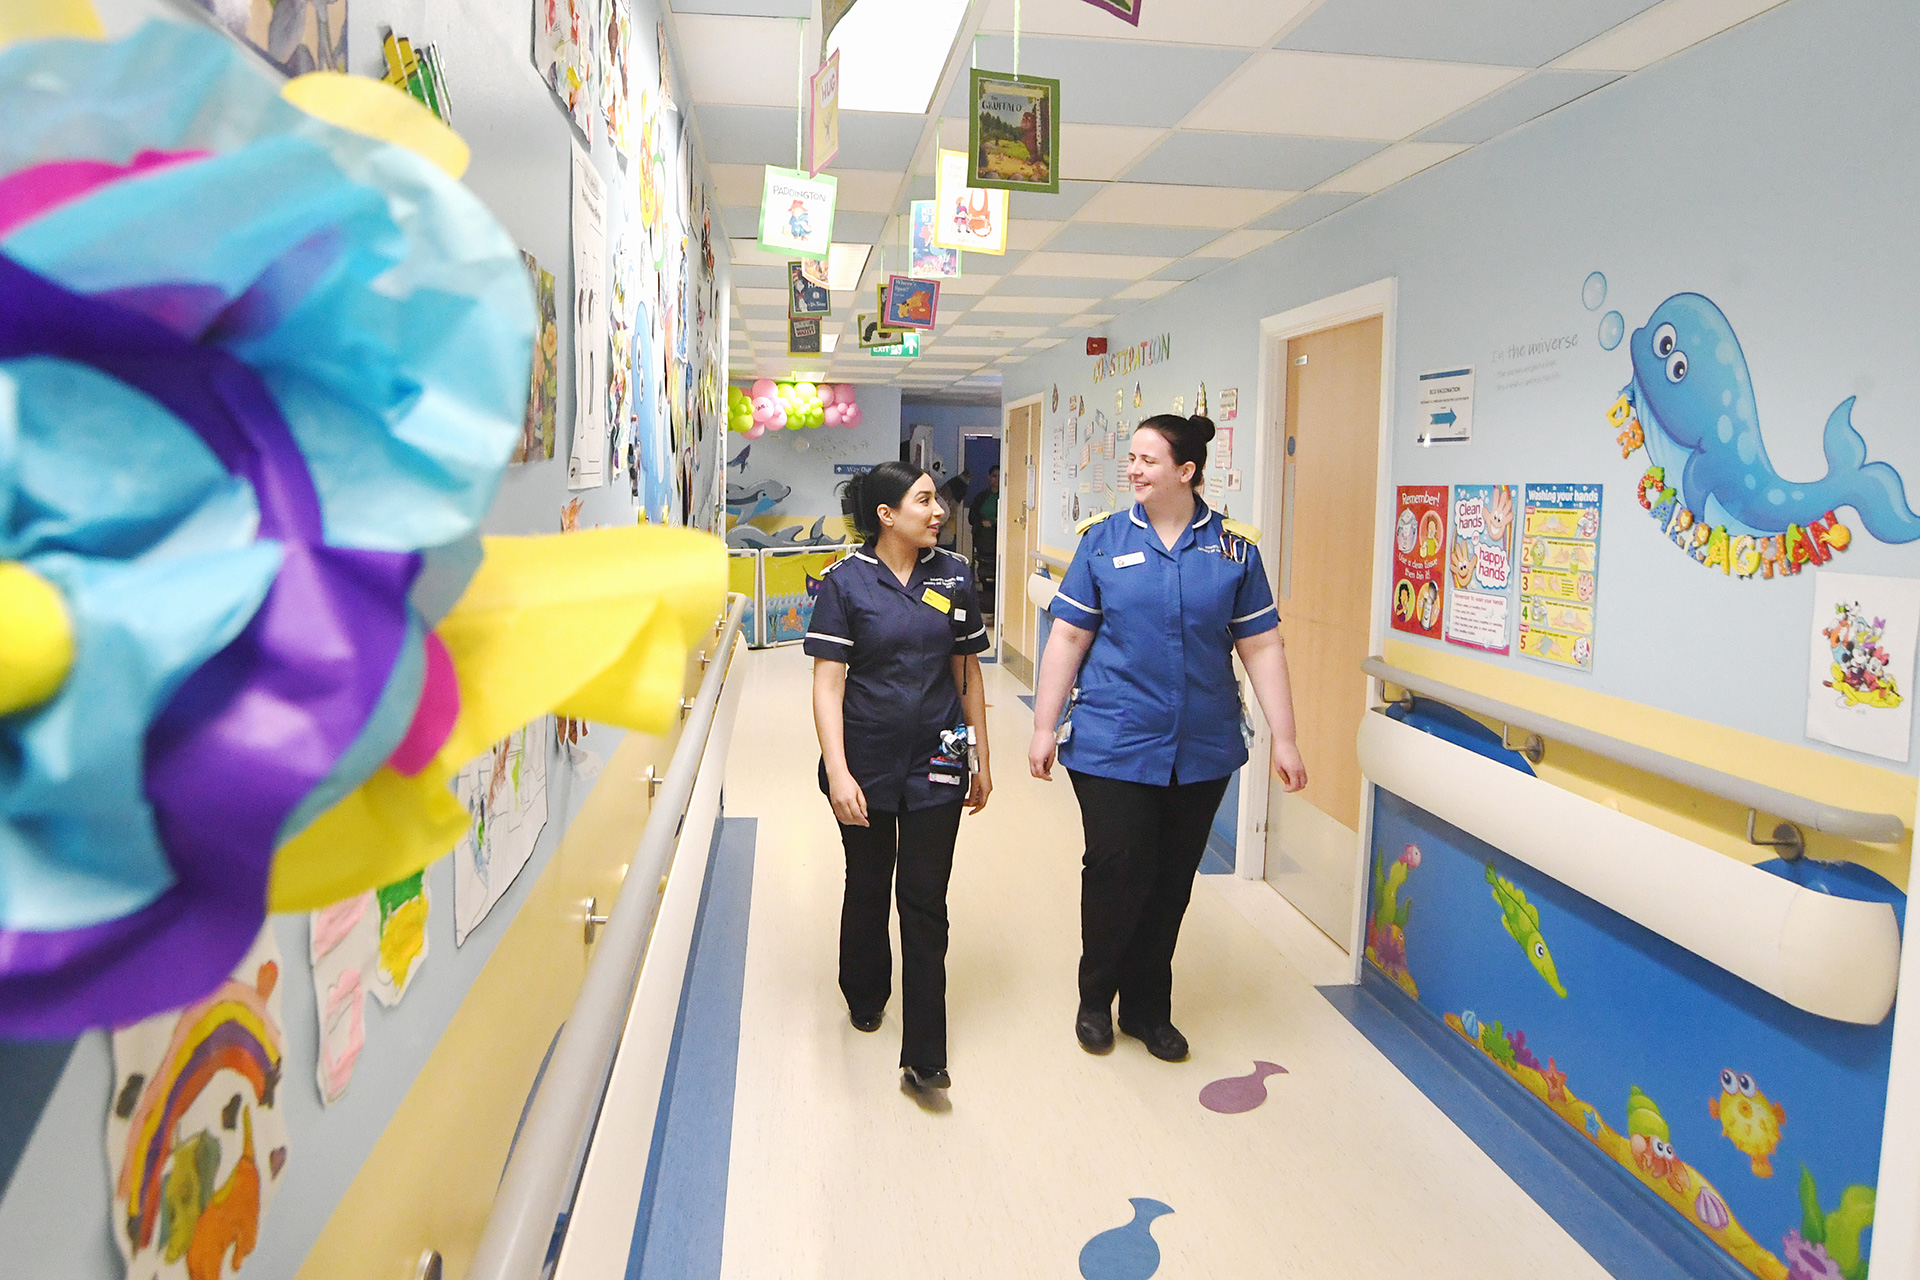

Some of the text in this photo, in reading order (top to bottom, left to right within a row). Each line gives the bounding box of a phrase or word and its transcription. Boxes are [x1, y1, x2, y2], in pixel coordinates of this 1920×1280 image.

[821, 74, 836, 102] HUG
[981, 100, 1022, 112] GRUFFALO
[773, 184, 827, 202] PADDINGTON
[1508, 344, 1525, 359] the
[1528, 333, 1578, 356] universe
[1093, 332, 1170, 384] CONSTIPATION
[1605, 395, 1644, 459] DR
[846, 466, 860, 475] Way
[1402, 490, 1440, 507] Remember!
[1528, 489, 1598, 503] Washing your hands
[1459, 503, 1481, 516] Clean
[1459, 517, 1482, 529] hands
[1526, 517, 1531, 532] 1
[1399, 552, 1407, 565] Use
[1412, 560, 1423, 569] clean
[1479, 547, 1505, 569] happy
[1523, 547, 1530, 562] 2
[1416, 570, 1424, 580] bin
[1479, 562, 1505, 581] hands
[1522, 576, 1529, 591] 3
[1522, 605, 1528, 620] 4
[1520, 635, 1526, 650] 5
